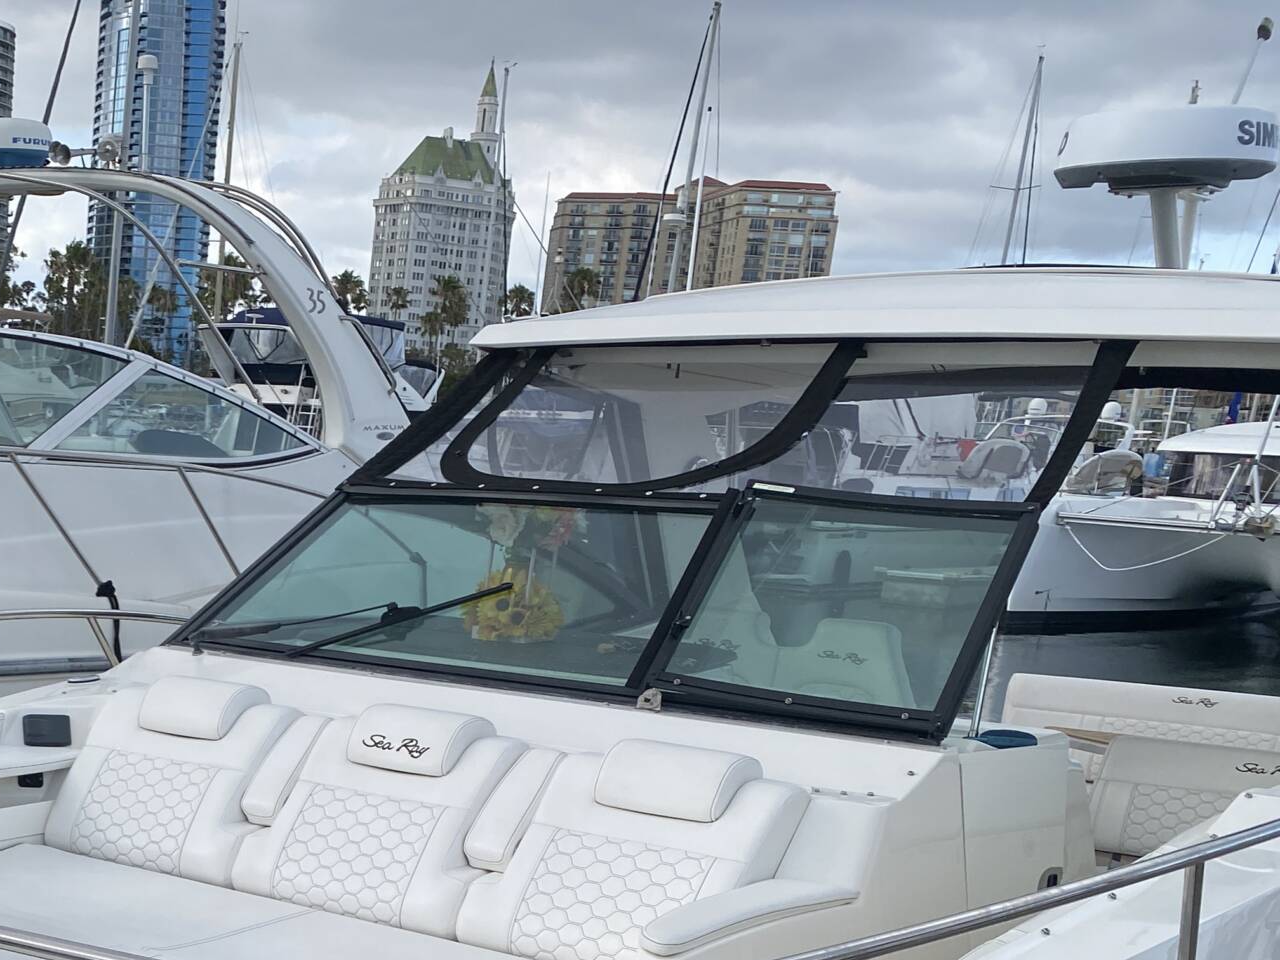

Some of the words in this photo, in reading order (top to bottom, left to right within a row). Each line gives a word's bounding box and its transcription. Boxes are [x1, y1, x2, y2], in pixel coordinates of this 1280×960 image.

[306, 287, 326, 314] 35
[1171, 696, 1193, 705] Sea
[1195, 697, 1219, 708] Ray
[362, 734, 394, 750] Sea
[396, 738, 430, 759] Ray
[1235, 762, 1268, 775] Sea
